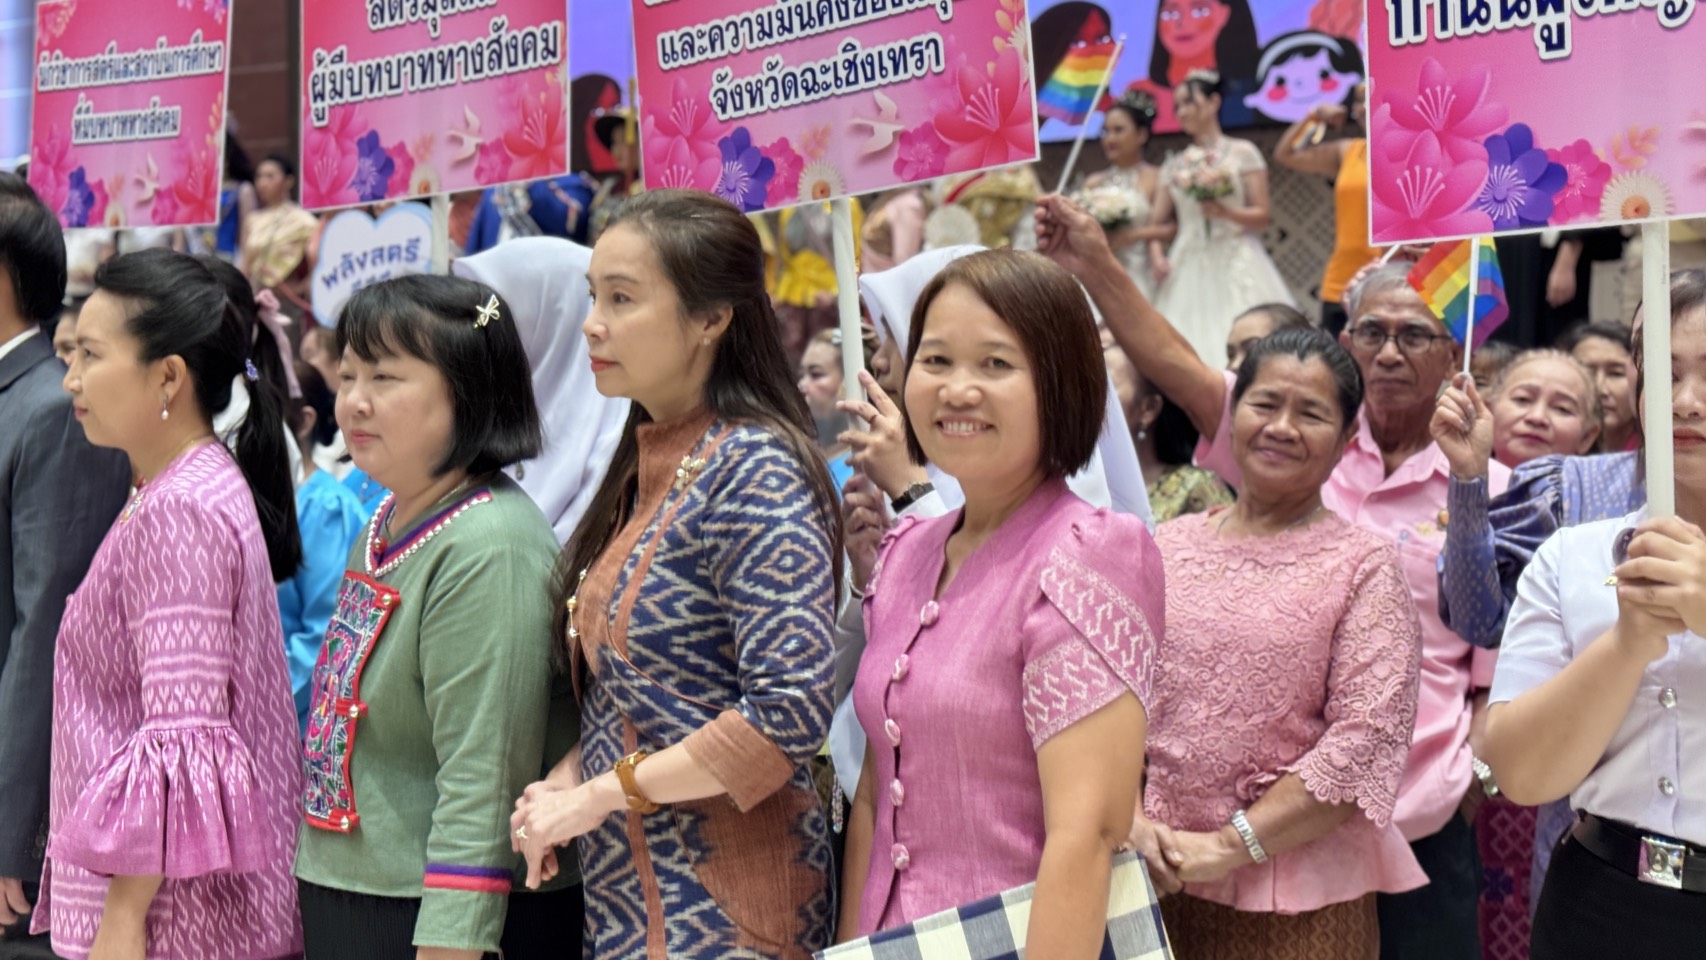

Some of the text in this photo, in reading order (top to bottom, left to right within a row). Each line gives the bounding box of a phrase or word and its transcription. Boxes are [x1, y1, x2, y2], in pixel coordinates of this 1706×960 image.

[311, 20, 558, 122] ผู้มีบทบาททางสังคม
[712, 37, 942, 115] จังหวัดฉะเชิงเทรา
[321, 236, 421, 290] พลังสตรี
